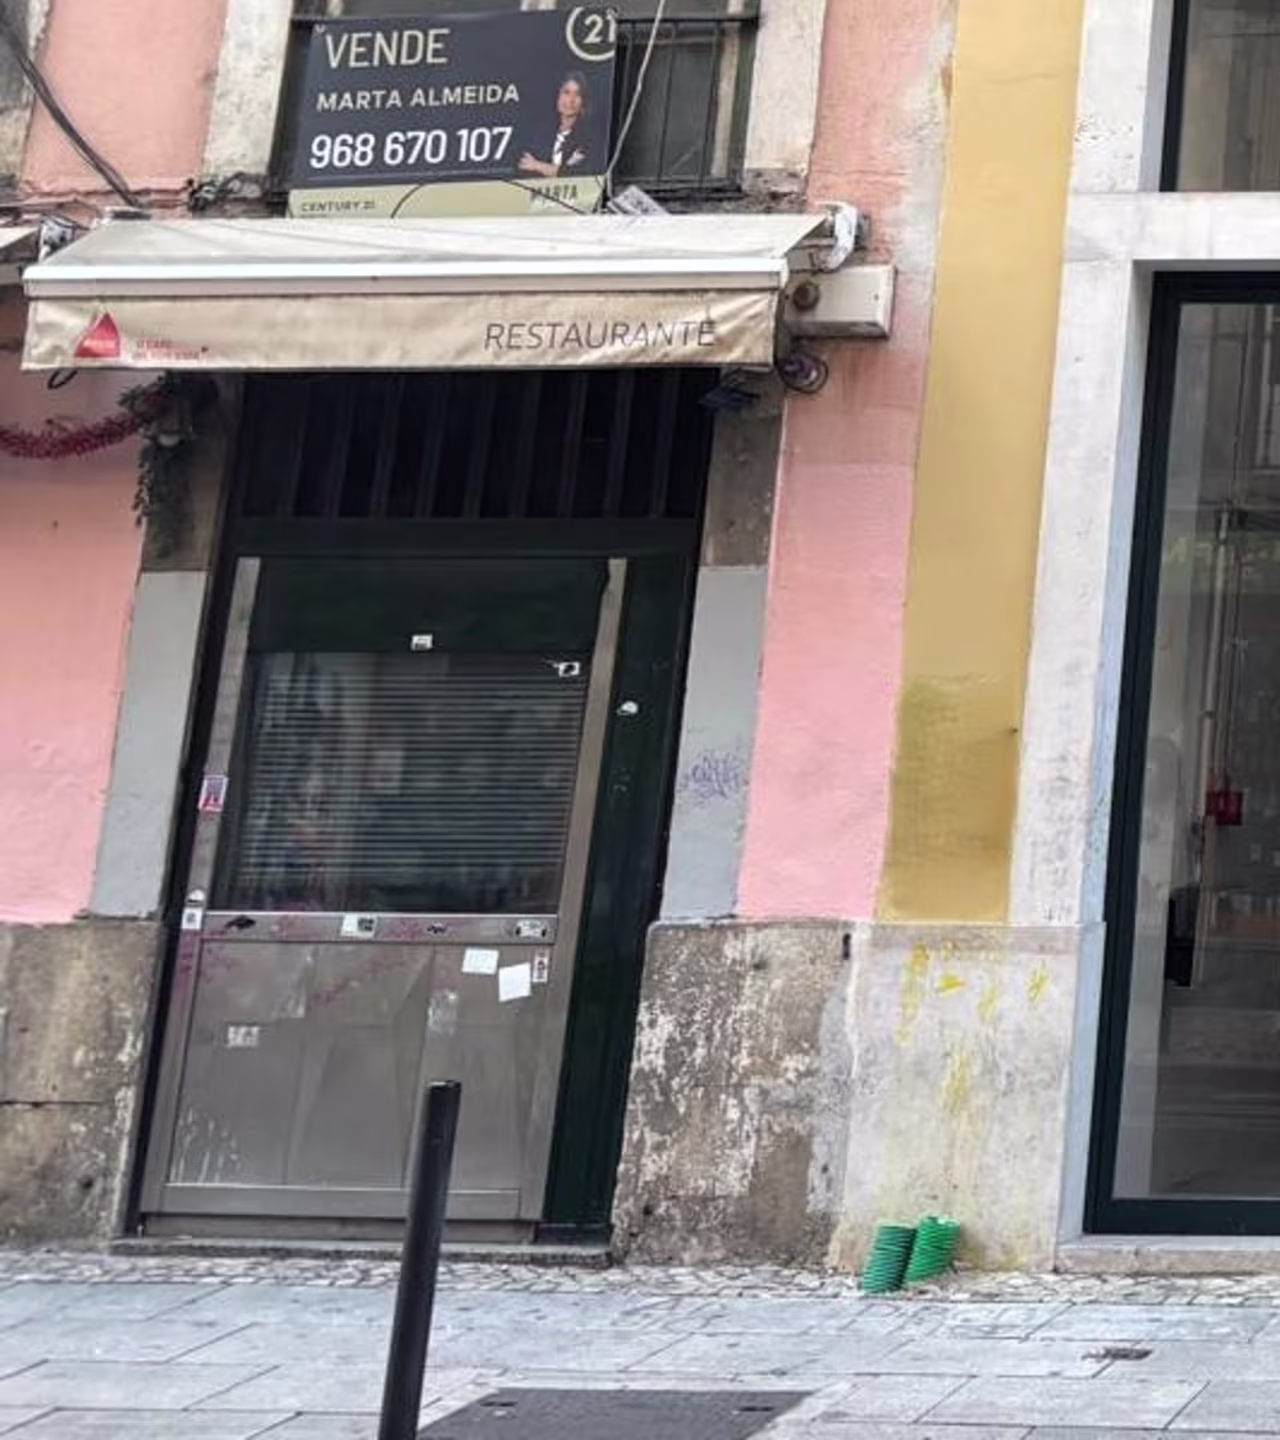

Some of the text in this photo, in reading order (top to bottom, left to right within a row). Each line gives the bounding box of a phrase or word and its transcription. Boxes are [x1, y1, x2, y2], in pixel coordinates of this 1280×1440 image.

[324, 27, 450, 69] VENDE
[316, 83, 520, 112] MARTA ALMEIDA
[309, 126, 514, 169] 968 670 107
[301, 200, 360, 212] CENTURY
[484, 320, 716, 350] RESTAURANTE
